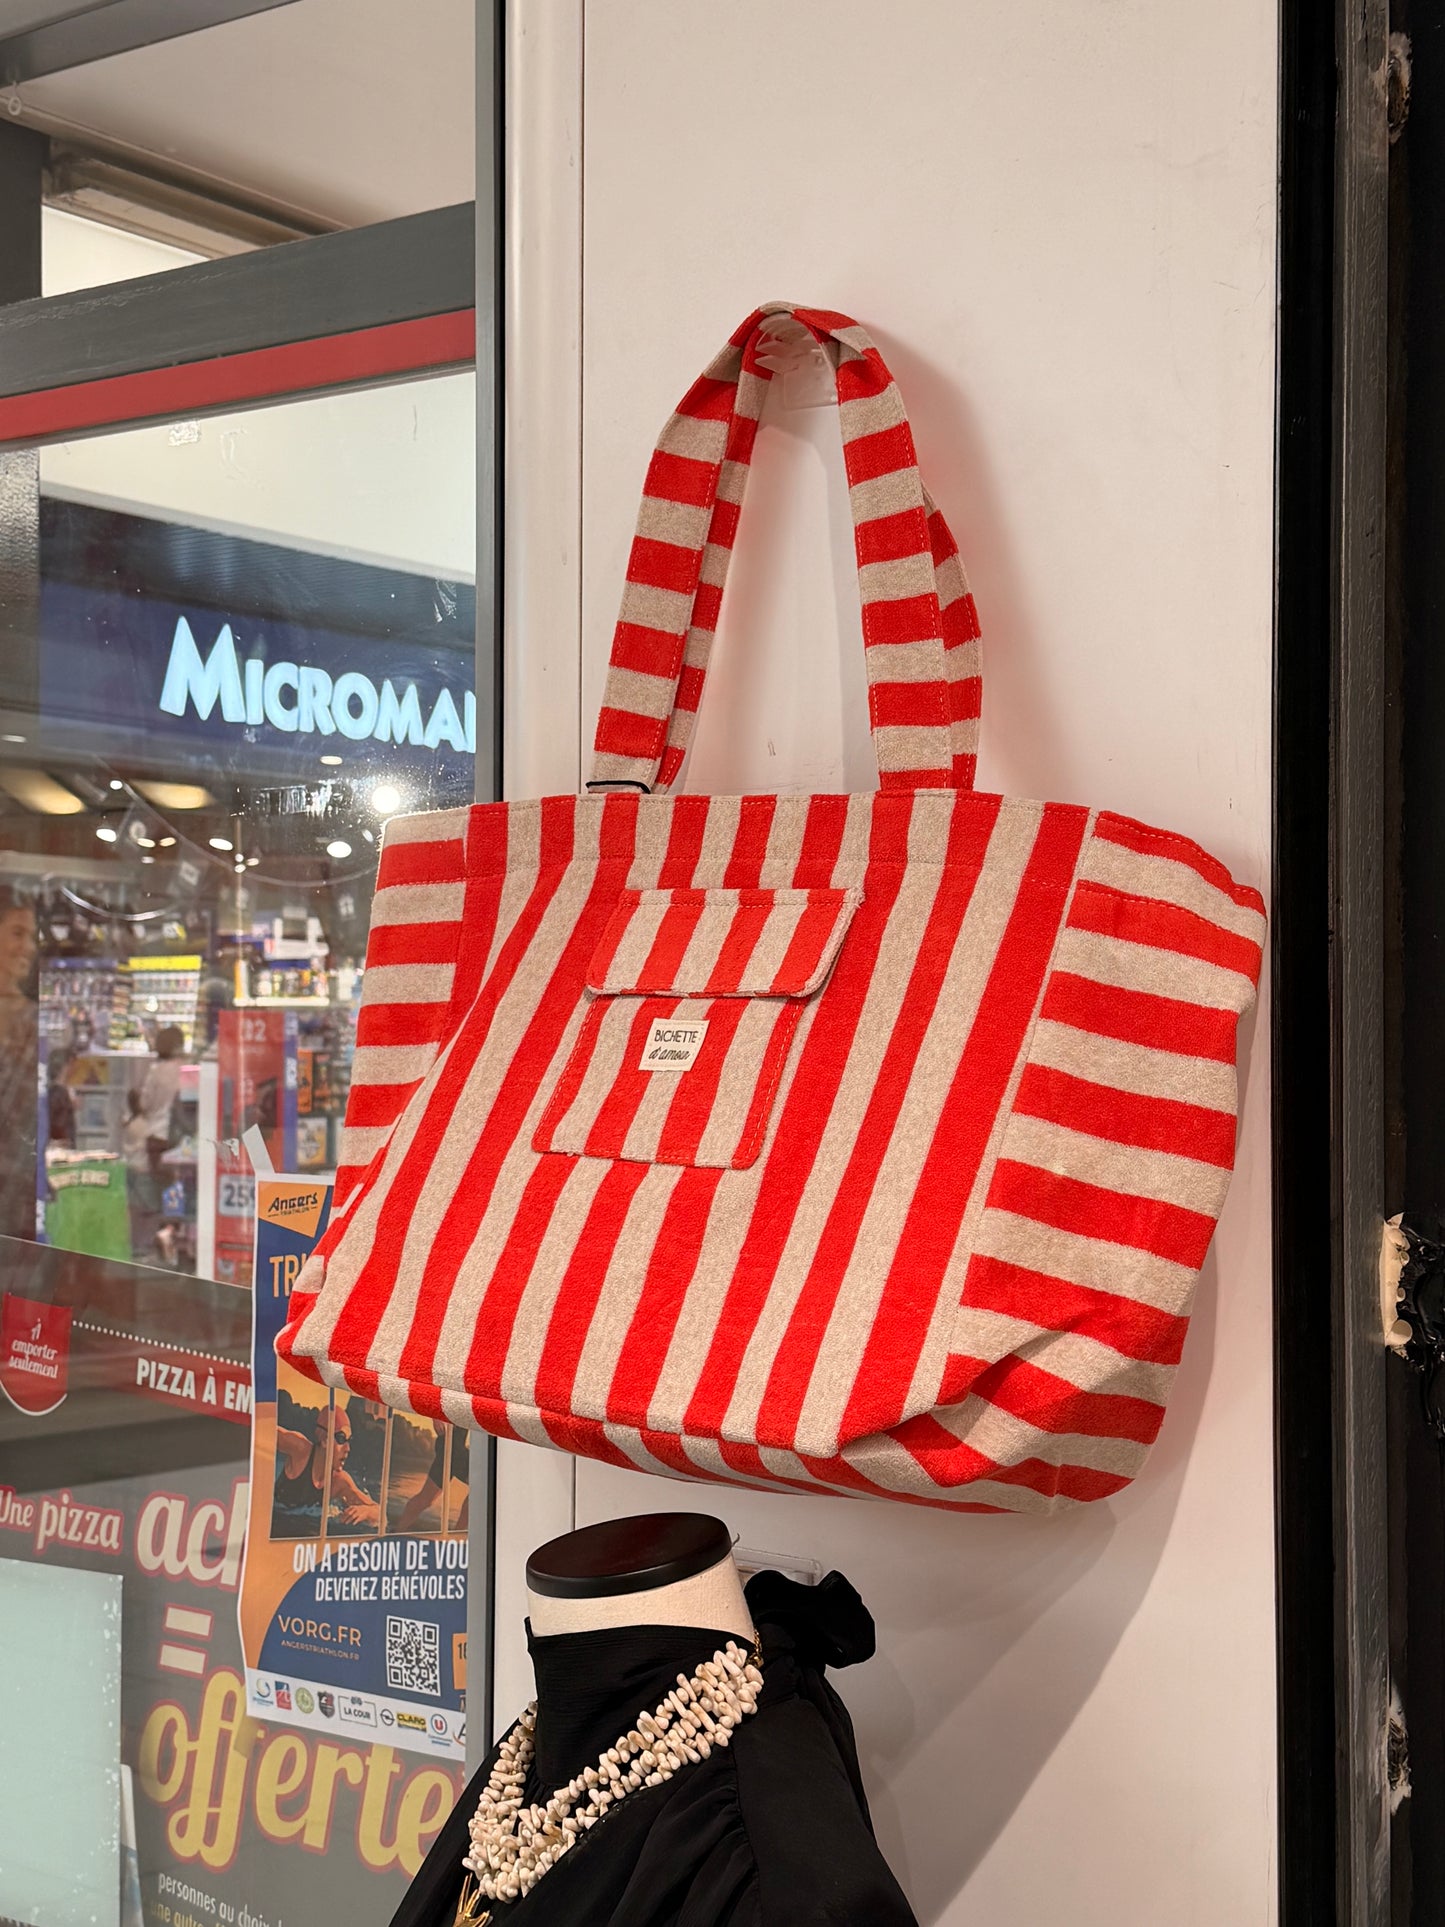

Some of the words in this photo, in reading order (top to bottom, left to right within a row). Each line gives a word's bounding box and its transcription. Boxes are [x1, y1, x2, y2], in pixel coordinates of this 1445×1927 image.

[654, 1029, 698, 1043] BICHETTE
[12, 1340, 58, 1360] emporter
[9, 1355, 59, 1379] seulement
[136, 1357, 196, 1400] PIZZA
[202, 1367, 217, 1405] À
[37, 1493, 121, 1550] pizza
[293, 1543, 317, 1573] ON
[320, 1543, 332, 1572] A
[337, 1541, 401, 1572] BESOIN
[405, 1540, 429, 1570] DE
[315, 1576, 378, 1601] DEVENEZ
[381, 1570, 465, 1601] BÉNÉVOLES
[277, 1614, 362, 1647] VORG.FR
[343, 1706, 353, 1716] LA
[158, 1872, 217, 1914] personnes
[219, 1902, 234, 1923] au
